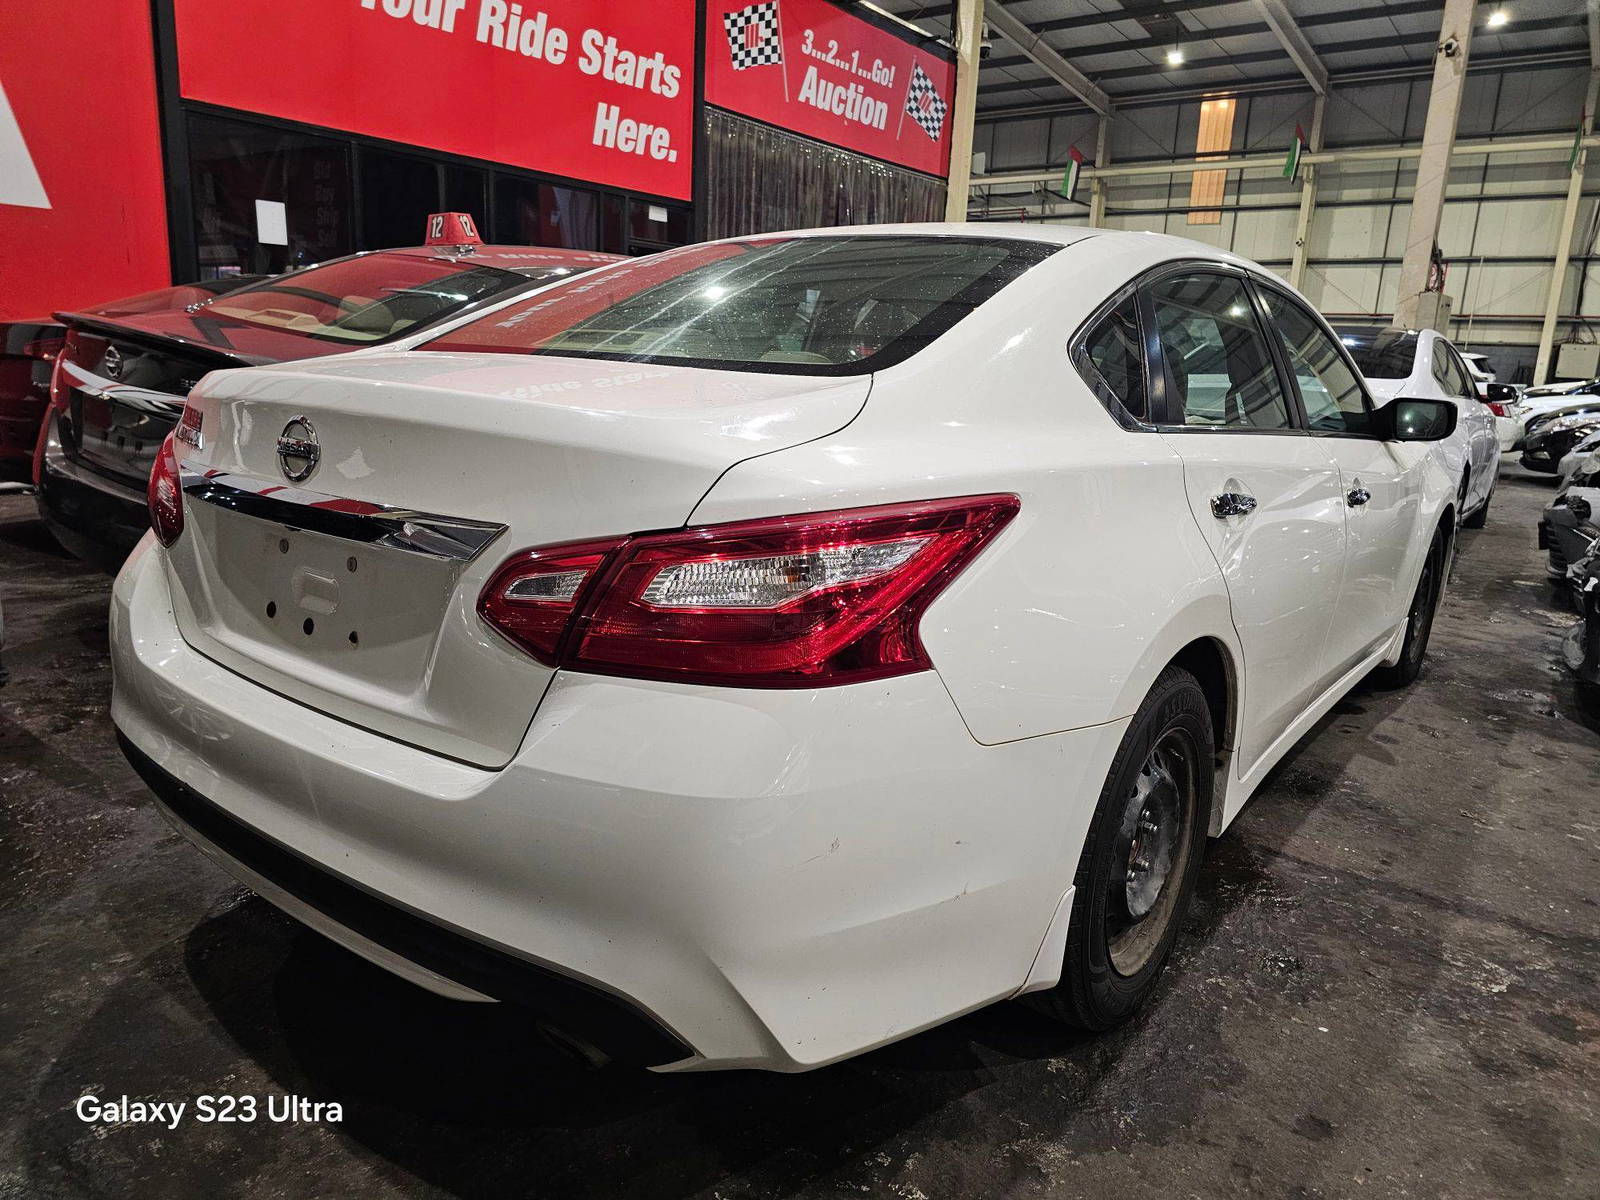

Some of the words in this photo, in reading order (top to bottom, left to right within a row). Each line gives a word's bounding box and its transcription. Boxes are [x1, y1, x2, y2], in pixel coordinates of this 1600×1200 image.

[361, 0, 466, 33] our
[476, 0, 569, 65] Ride
[578, 28, 682, 99] Starts
[798, 65, 889, 131] Auction
[592, 102, 678, 163] Here.
[431, 216, 444, 238] 12
[277, 439, 315, 458] NISSAN
